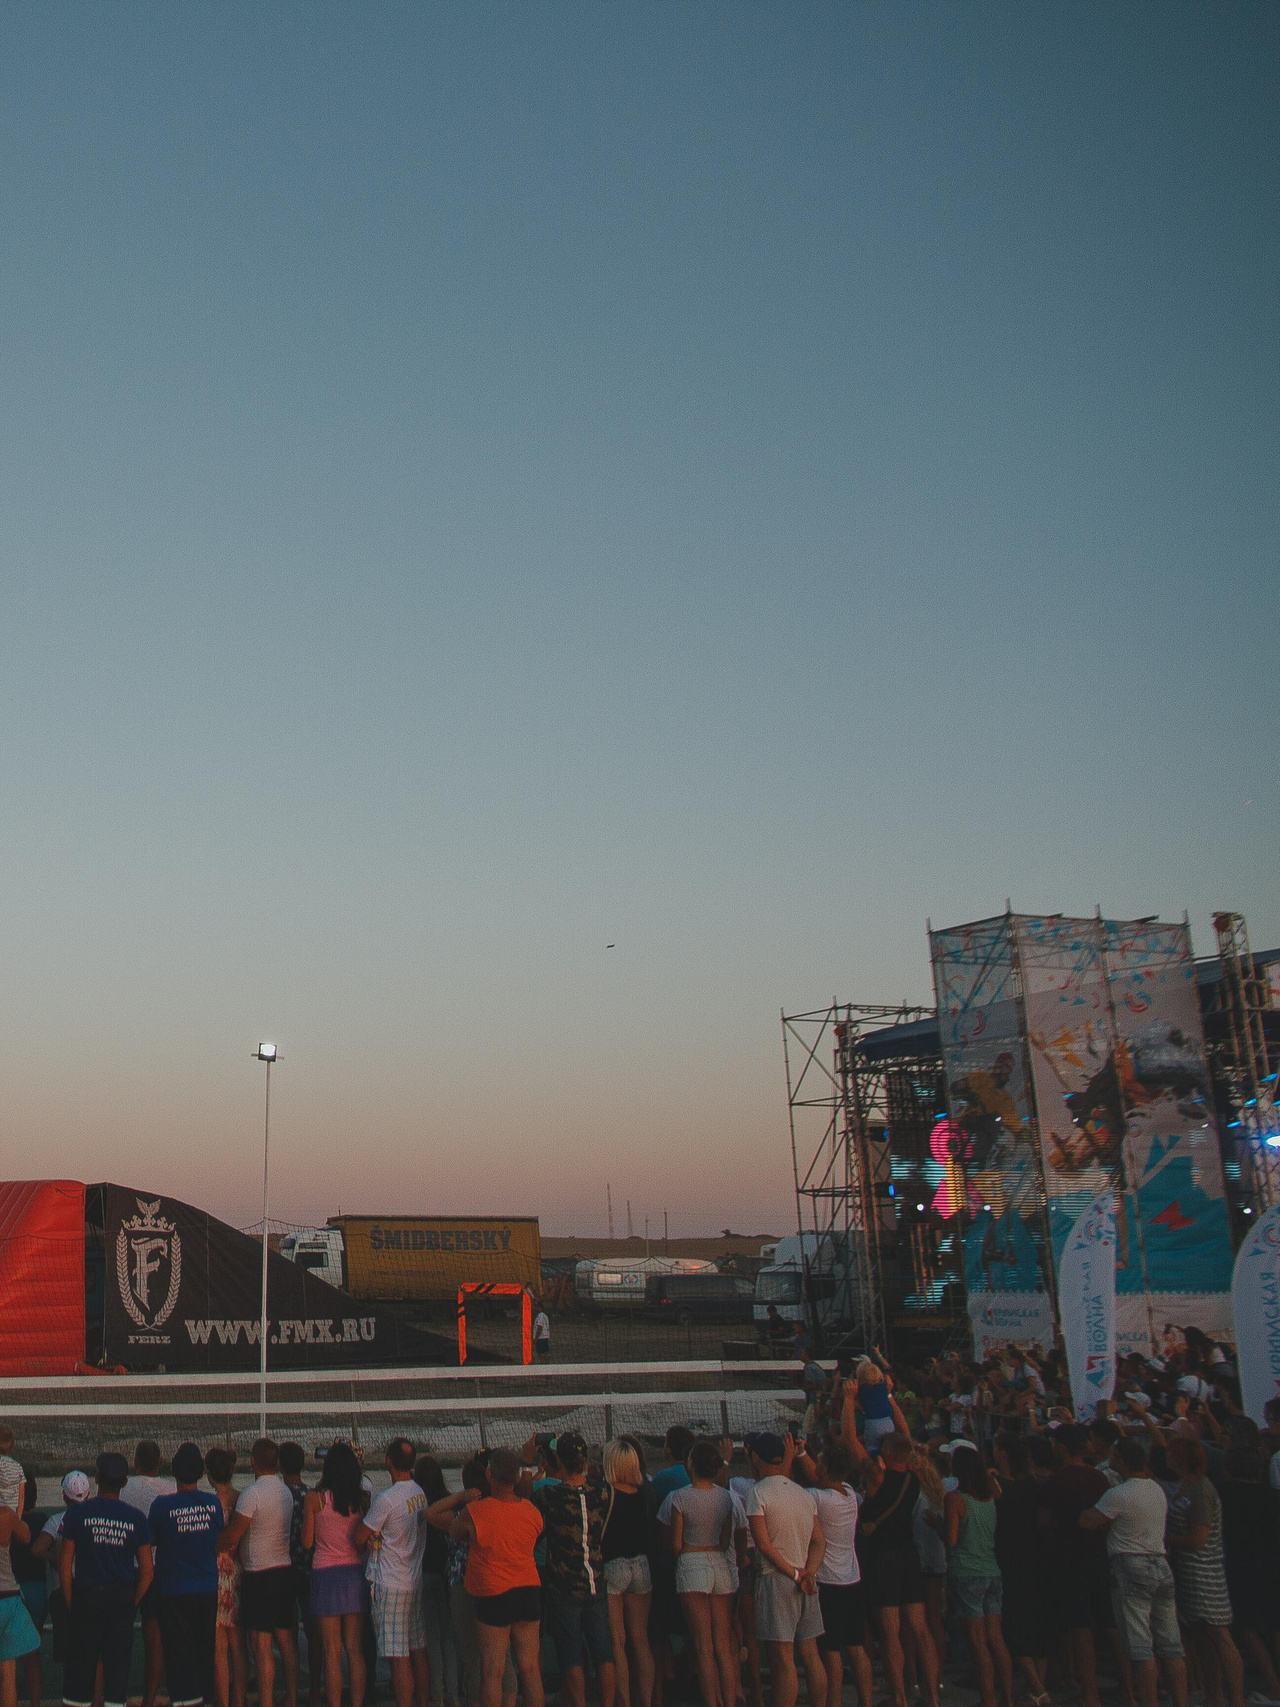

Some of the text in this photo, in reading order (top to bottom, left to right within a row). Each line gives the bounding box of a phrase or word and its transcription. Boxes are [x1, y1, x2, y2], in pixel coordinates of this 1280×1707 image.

[1090, 1294, 1109, 1353] ВОЛНА
[184, 1316, 377, 1345] WWW.FMX.RU
[128, 1335, 171, 1344] FERZ
[169, 1505, 217, 1518] ПОЖАРНАЯ
[84, 1517, 134, 1532] ПОЖАРНАЯ
[176, 1513, 211, 1524] ОХРАНА
[91, 1526, 127, 1539] ОХРАНА
[177, 1522, 210, 1533] КРЫМА
[93, 1535, 124, 1547] КРЫМА
